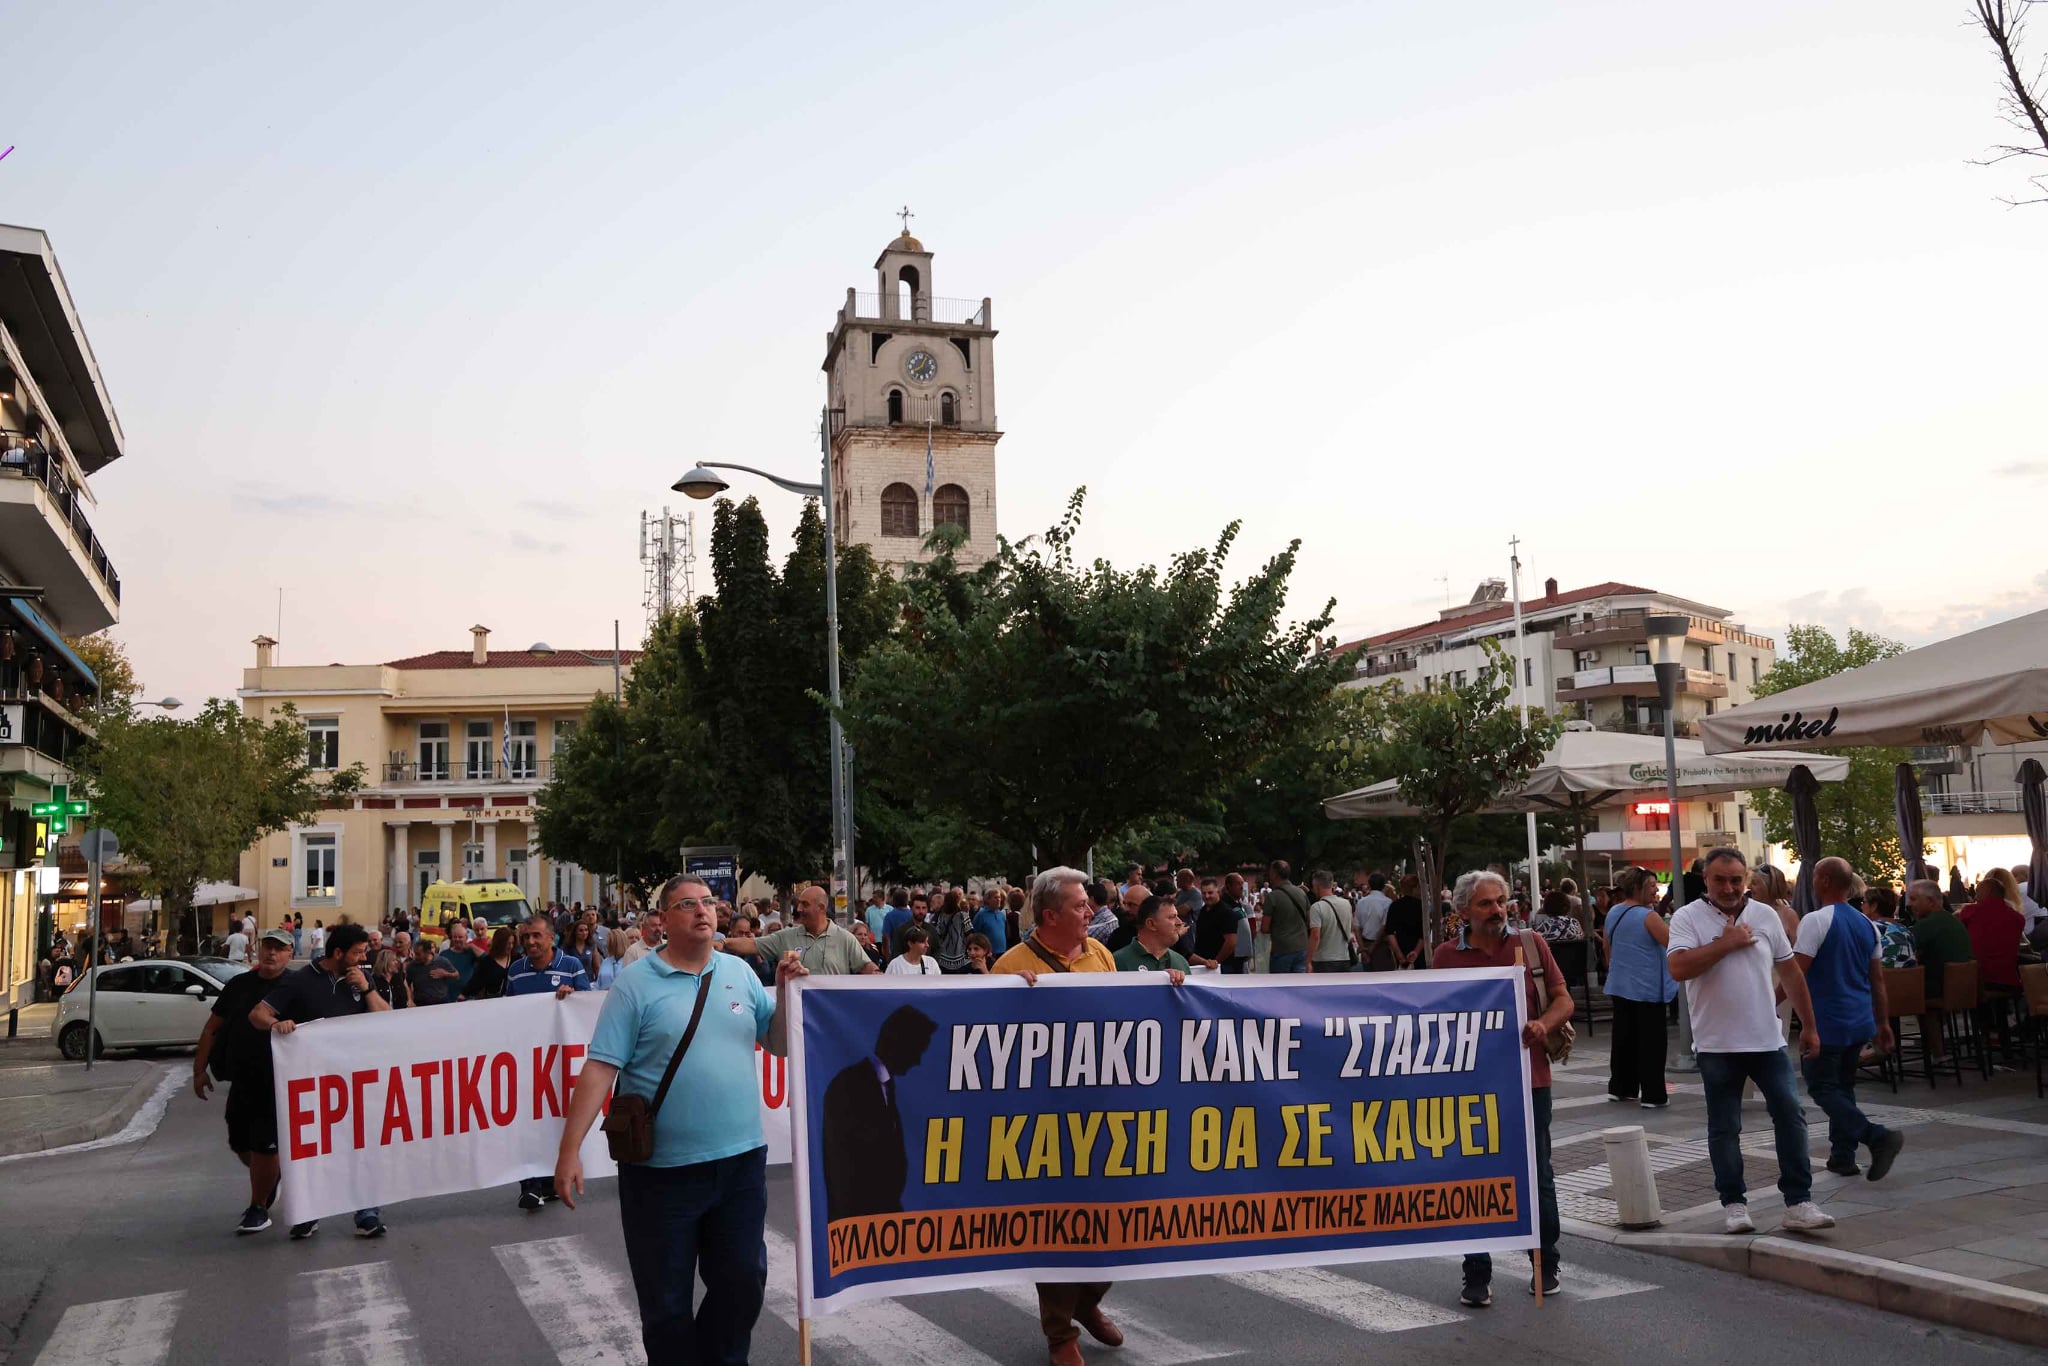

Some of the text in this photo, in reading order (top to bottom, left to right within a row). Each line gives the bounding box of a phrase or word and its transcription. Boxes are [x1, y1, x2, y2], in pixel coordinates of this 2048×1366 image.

[1744, 707, 1839, 745] mikel
[1629, 763, 1681, 782] Carlsbeg
[1682, 768, 1713, 777] Probably
[466, 809, 533, 818] ΔΗΜΑΡΧΕ
[948, 1019, 1162, 1091] ΚΥΡΙΑΚΟ
[1179, 1018, 1301, 1083] ΚΑΝΕ
[288, 1051, 517, 1160] ΕΡΓΑΤΙΚΟ
[924, 1093, 1500, 1184] Η ΚΑΥΣΗ ΘΑ ΣΕ ΚΑΨΕΙ
[831, 1183, 1513, 1268] ΣΥΛΛΟΓΟΙ ΔΗΜΟΤΙΚΩΝ ΥΠΑΛΛΗΛΩΝ ΔΥΤΙΚΗΣ ΜΑΚΕΔΟΝΙΑΣ
